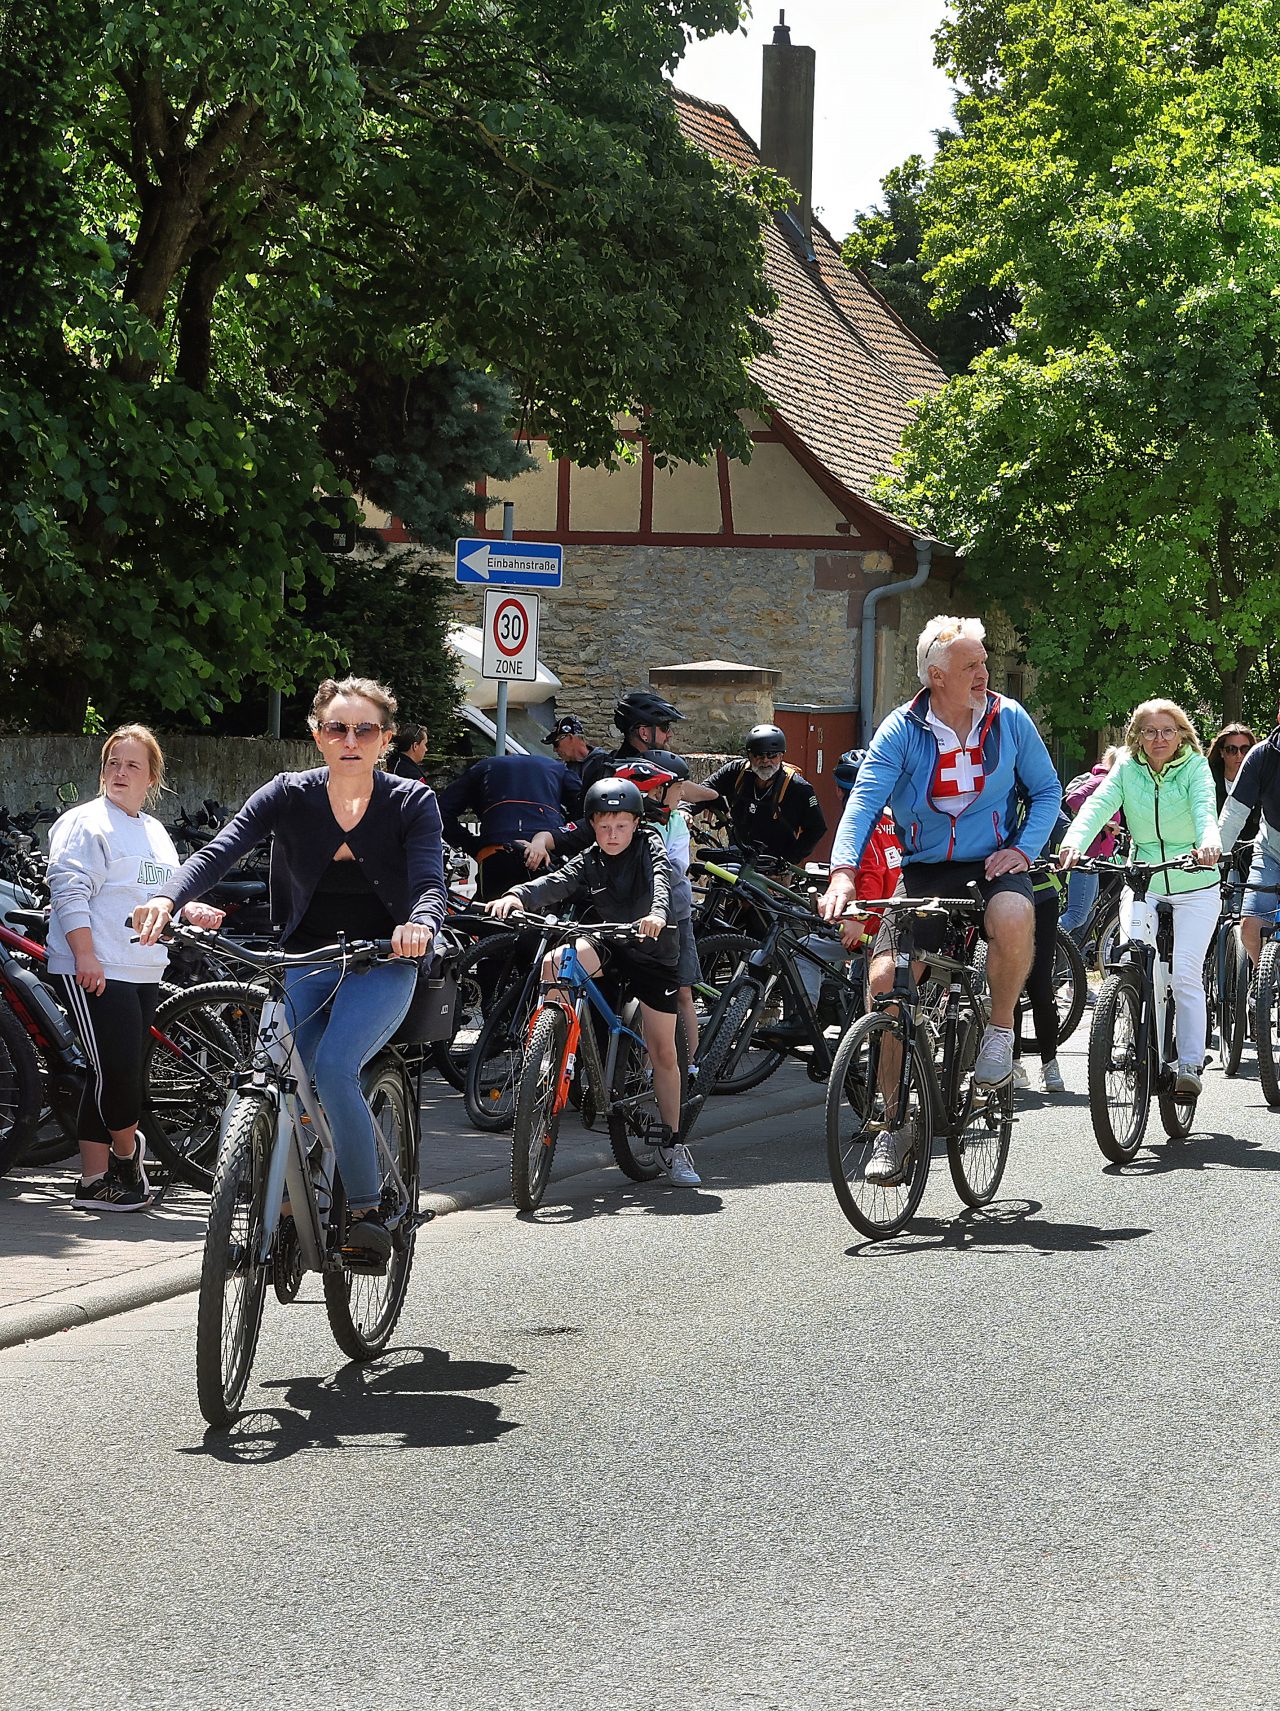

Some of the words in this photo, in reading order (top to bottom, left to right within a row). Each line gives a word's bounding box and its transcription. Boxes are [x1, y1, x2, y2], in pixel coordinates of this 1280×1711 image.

[487, 557, 556, 571] Einbahnstraße
[500, 613, 522, 641] 30
[495, 659, 523, 675] ZONE
